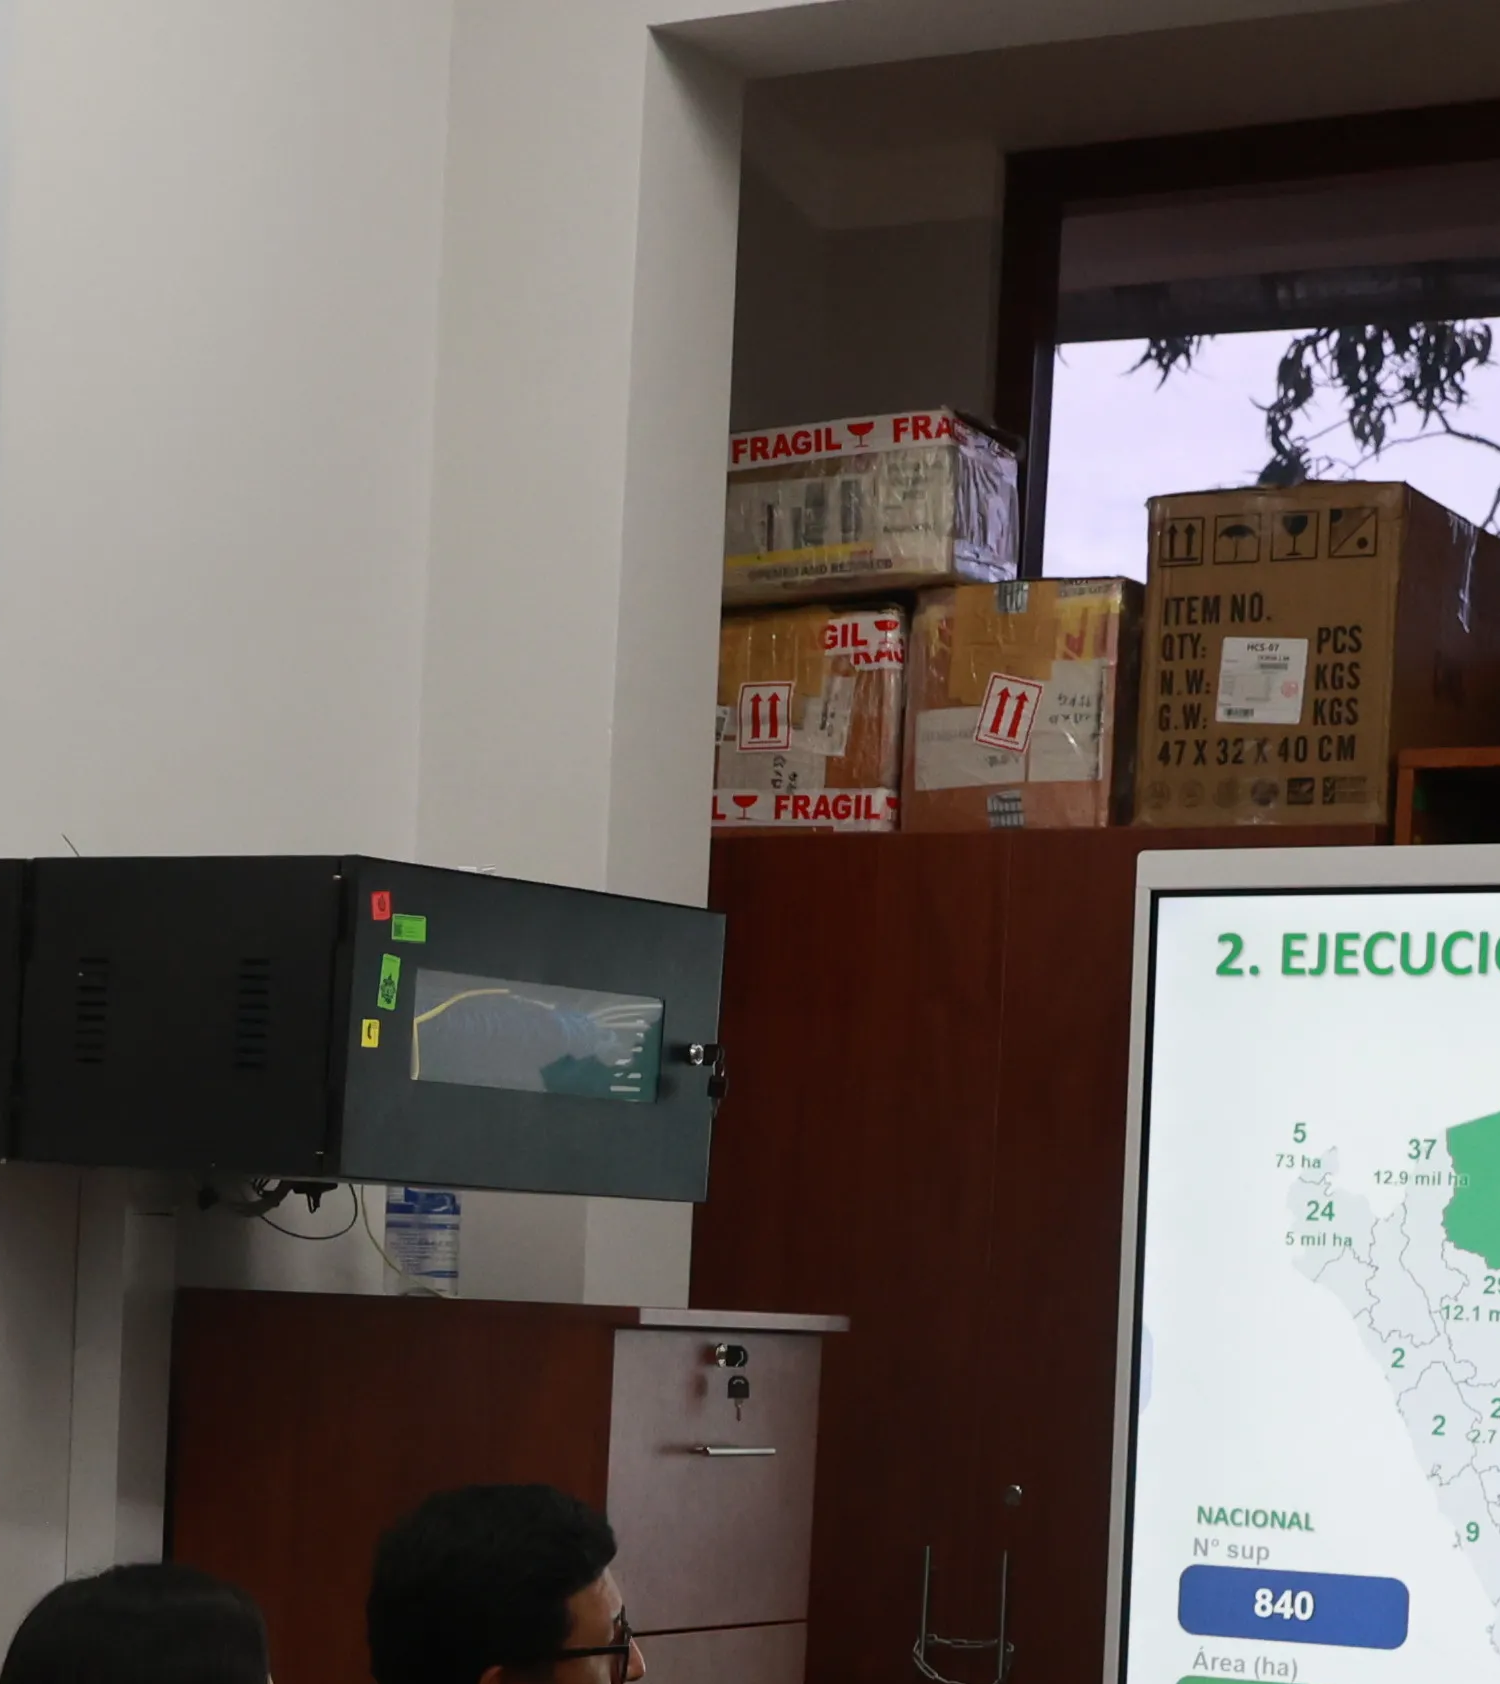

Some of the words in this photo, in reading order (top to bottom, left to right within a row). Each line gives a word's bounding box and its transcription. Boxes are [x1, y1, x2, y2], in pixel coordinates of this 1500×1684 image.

[731, 427, 843, 464] FRAGIL
[1163, 596, 1221, 626] ITEM
[1230, 593, 1272, 623] NO.
[1161, 633, 1206, 662] QTY:
[1316, 626, 1363, 655] PCS
[1160, 668, 1211, 696] N.W:
[1314, 663, 1361, 691] KGS
[1158, 704, 1208, 731] G.W:
[1313, 698, 1359, 726] KGS
[1157, 740, 1186, 766] 47
[1216, 737, 1245, 765] 32
[1277, 735, 1308, 763] 40
[1318, 735, 1356, 762] CM
[774, 794, 881, 821] FRAGIL
[1214, 930, 1262, 978] 2.
[1292, 1122, 1308, 1144] 5
[1275, 1154, 1296, 1168] 73
[1301, 1155, 1322, 1169] ha
[1407, 1138, 1437, 1160] 37
[1373, 1170, 1409, 1186] 12.9
[1414, 1171, 1441, 1186] mil
[1448, 1172, 1469, 1188] ha
[1306, 1200, 1336, 1222] 24
[1285, 1231, 1296, 1246] 5
[1300, 1232, 1327, 1247] mil
[1332, 1233, 1353, 1248] ha
[1390, 1347, 1406, 1369] 2
[1431, 1414, 1447, 1436] 2
[1471, 1428, 1497, 1445] 2.7
[1196, 1505, 1315, 1532] NACIONAL
[1465, 1521, 1481, 1543] 9
[1226, 1541, 1271, 1565] sup
[1253, 1587, 1314, 1621] 840
[1192, 1645, 1246, 1675] Área
[1253, 1655, 1299, 1683] (ha)
